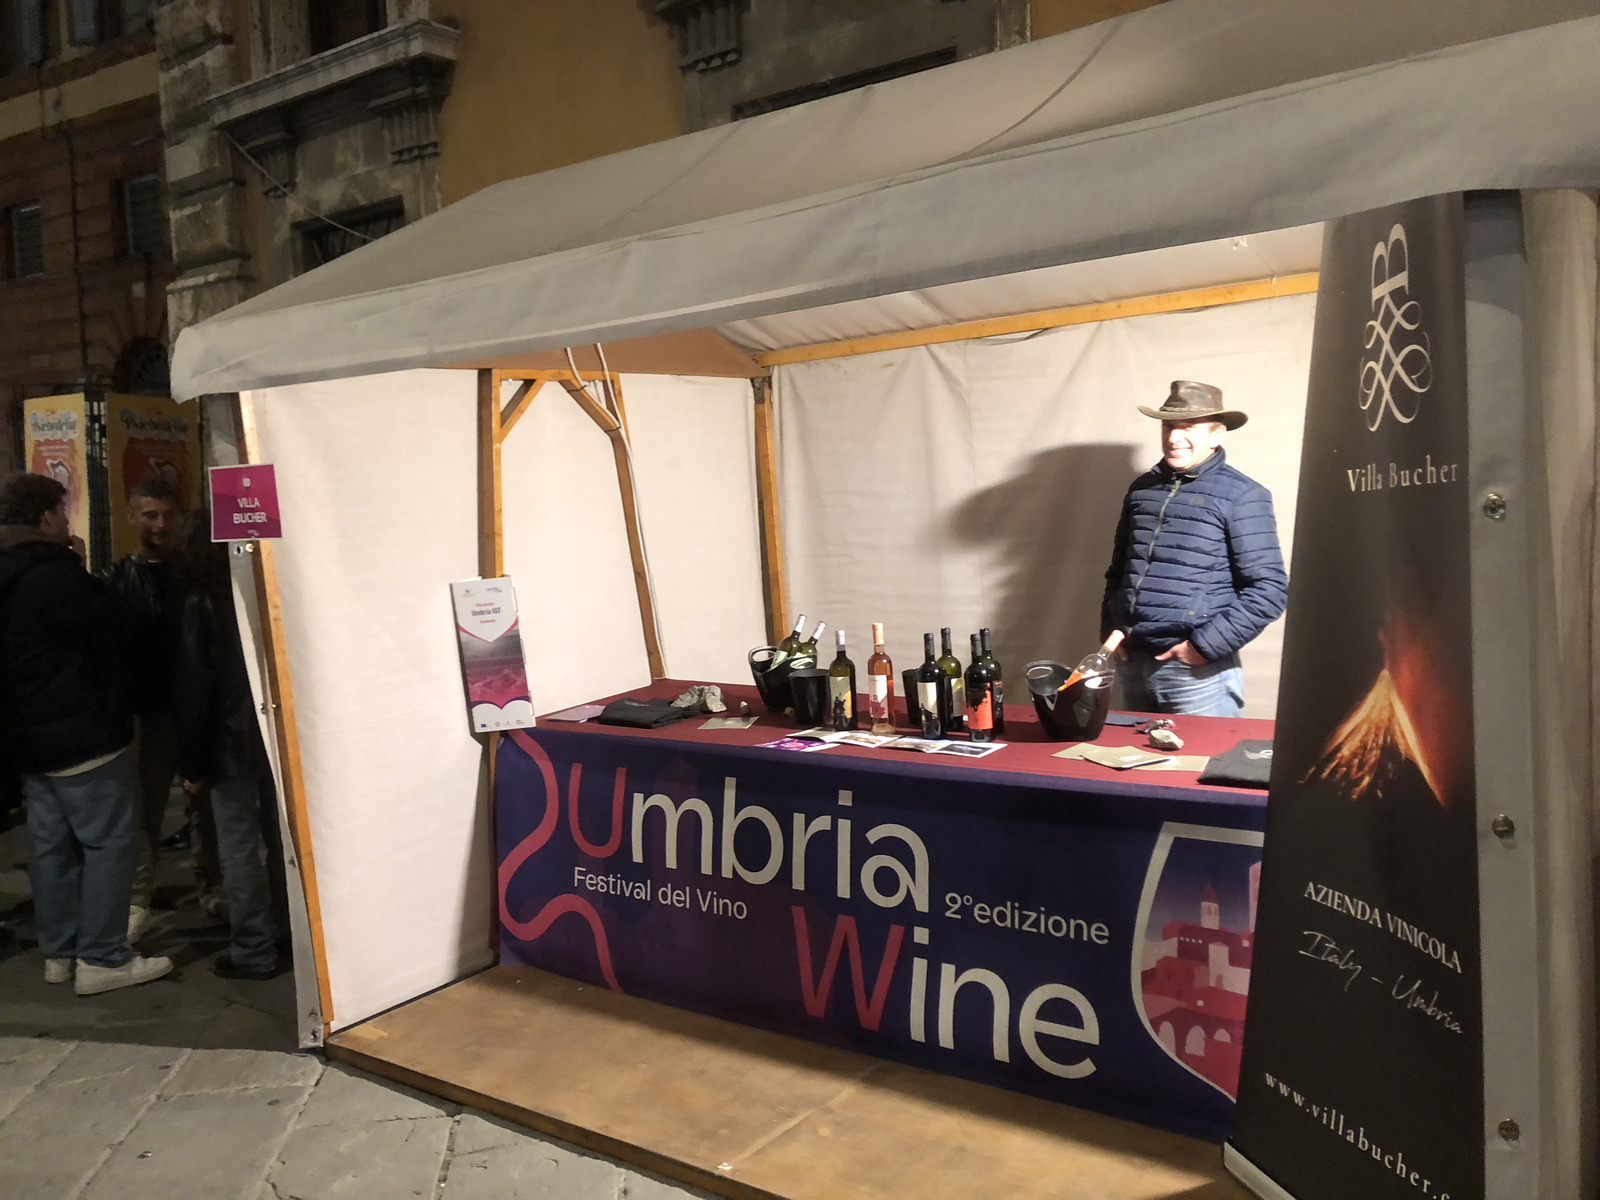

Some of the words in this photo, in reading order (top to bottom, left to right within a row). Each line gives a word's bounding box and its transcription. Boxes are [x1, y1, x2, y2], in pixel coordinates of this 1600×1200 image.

[237, 497, 260, 508] VILLA
[1347, 464, 1383, 493] Villa
[1389, 455, 1458, 488] Bucher
[233, 512, 267, 524] BUCHER
[568, 762, 930, 914] Umbria
[573, 866, 652, 902] Festival
[658, 883, 691, 909] del
[697, 888, 748, 919] Vino
[1303, 881, 1383, 929] AZIENDA
[1386, 912, 1463, 974] VINICOLA
[791, 905, 1100, 1080] Wine
[1298, 930, 1362, 992] Italy
[1391, 974, 1464, 1034] Umbria
